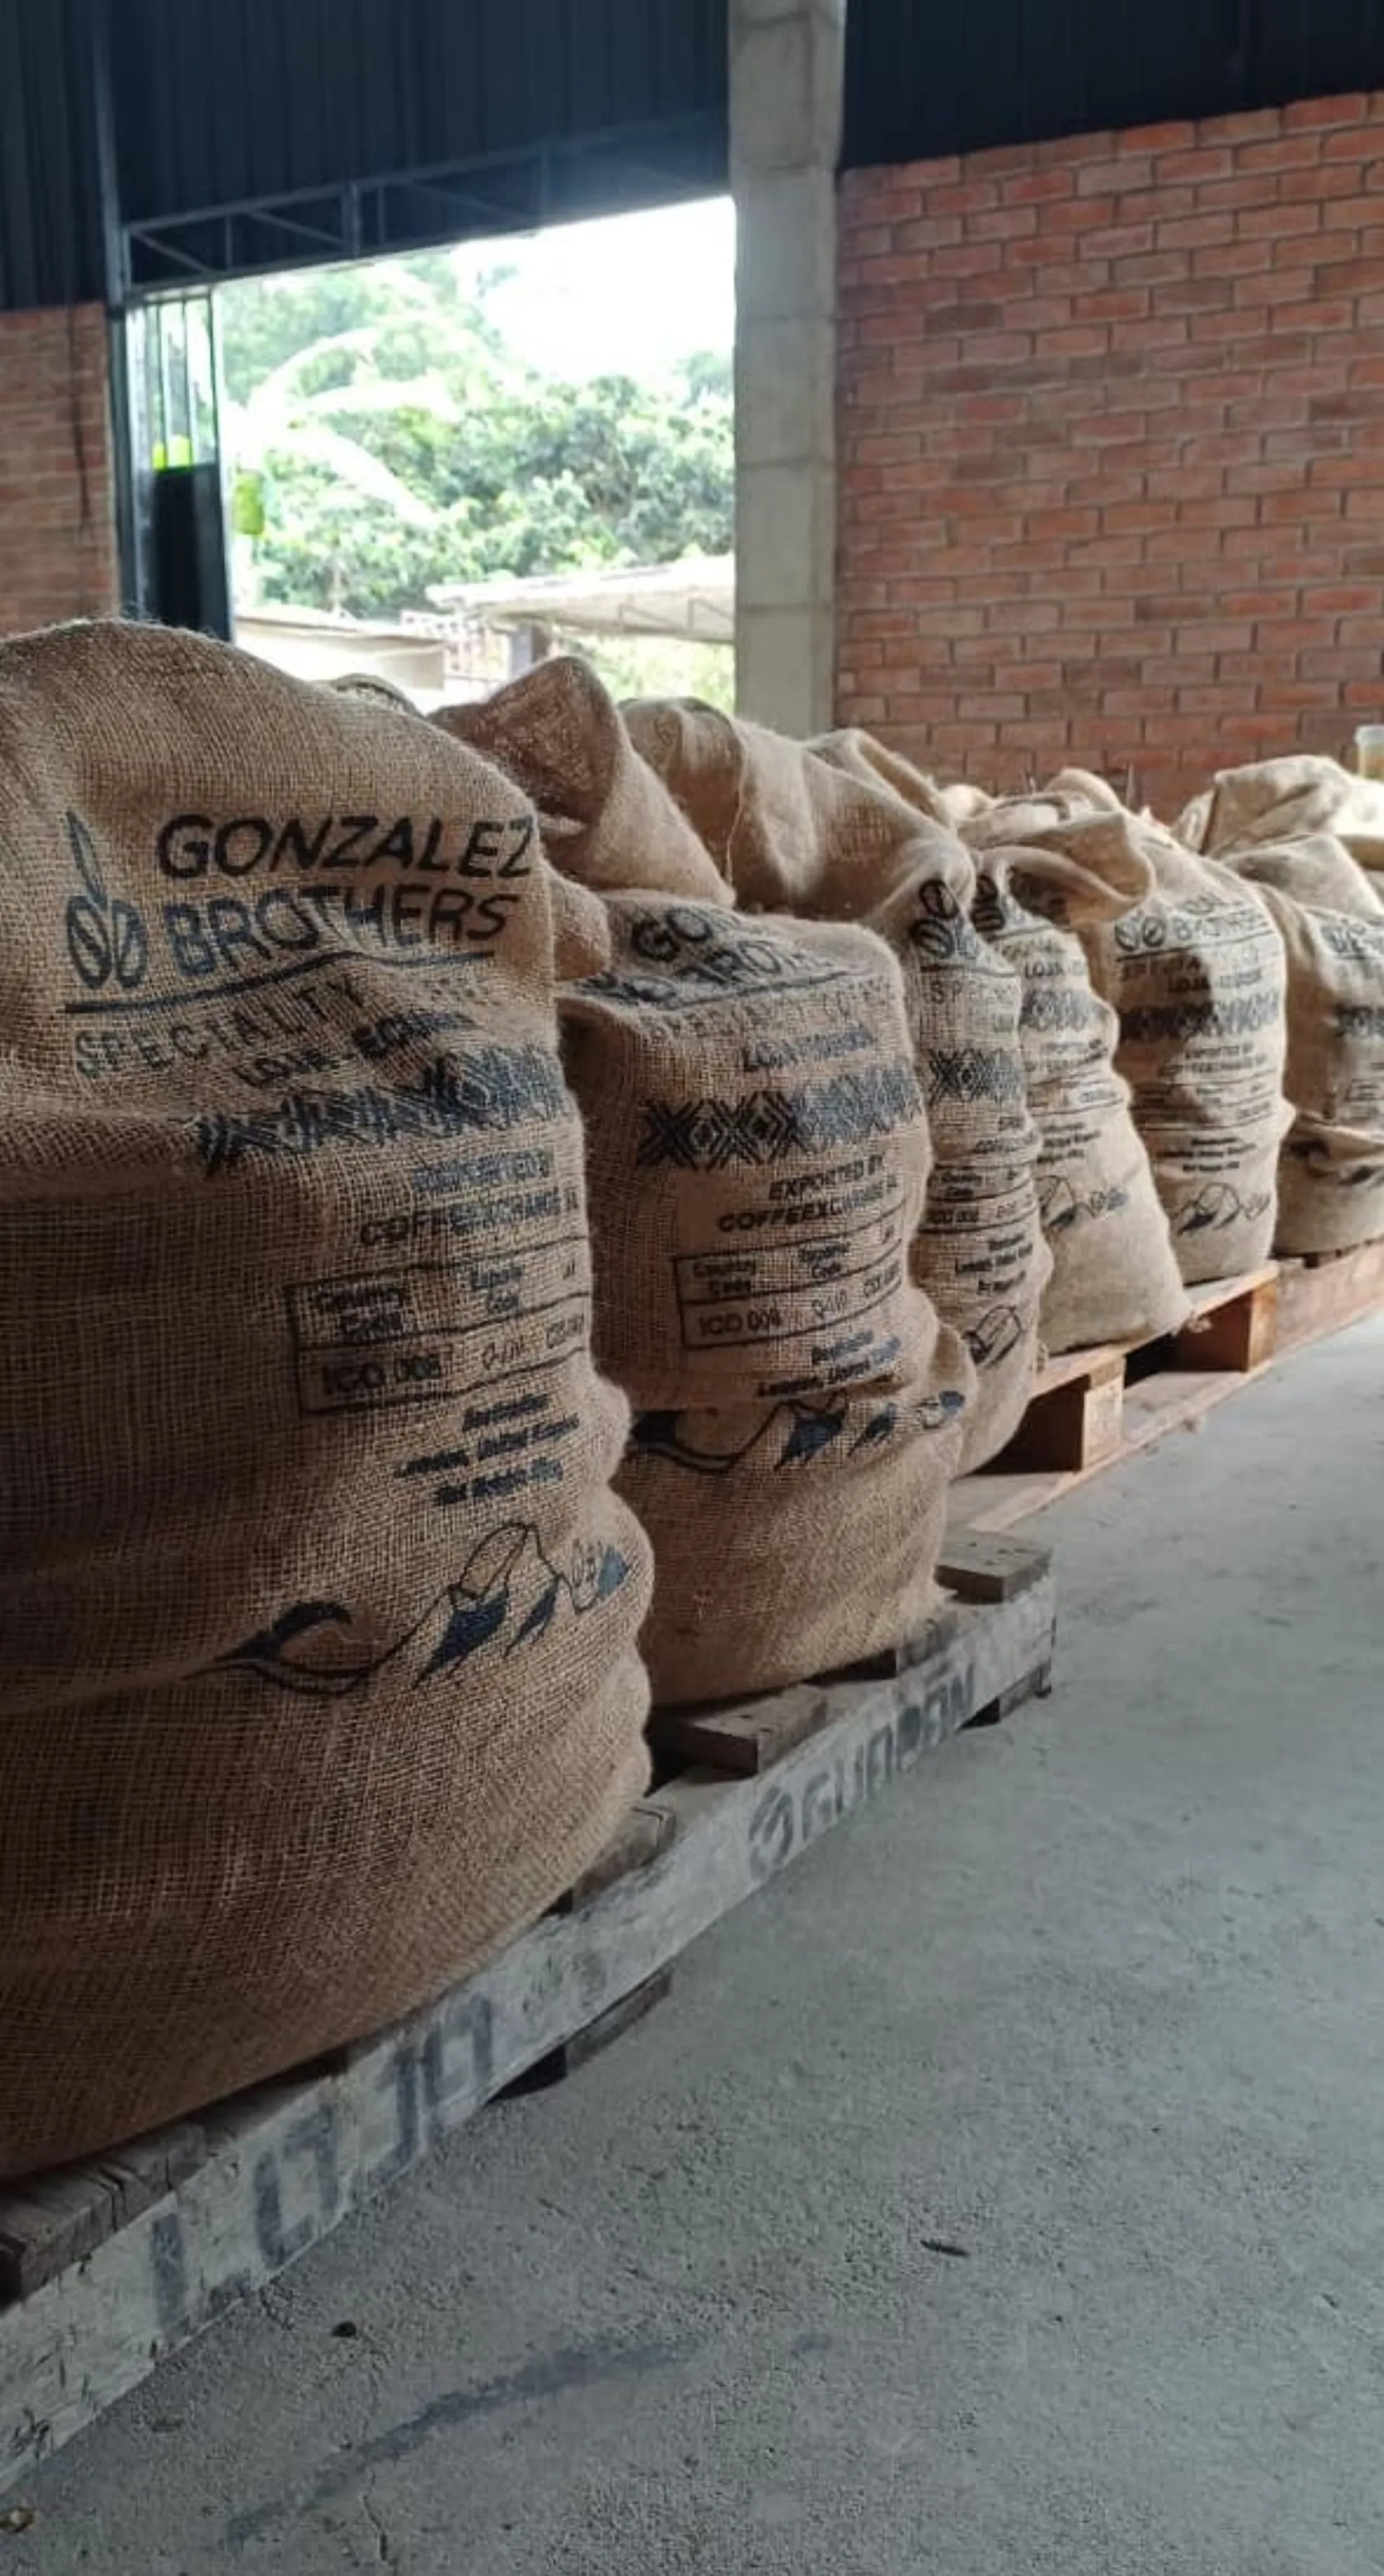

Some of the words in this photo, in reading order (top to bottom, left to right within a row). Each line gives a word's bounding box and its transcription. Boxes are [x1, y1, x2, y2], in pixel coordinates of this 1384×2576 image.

[154, 812, 536, 881] GONZALEZ
[163, 881, 520, 978] BROTHERS
[74, 974, 366, 1080] SPECIALTY
